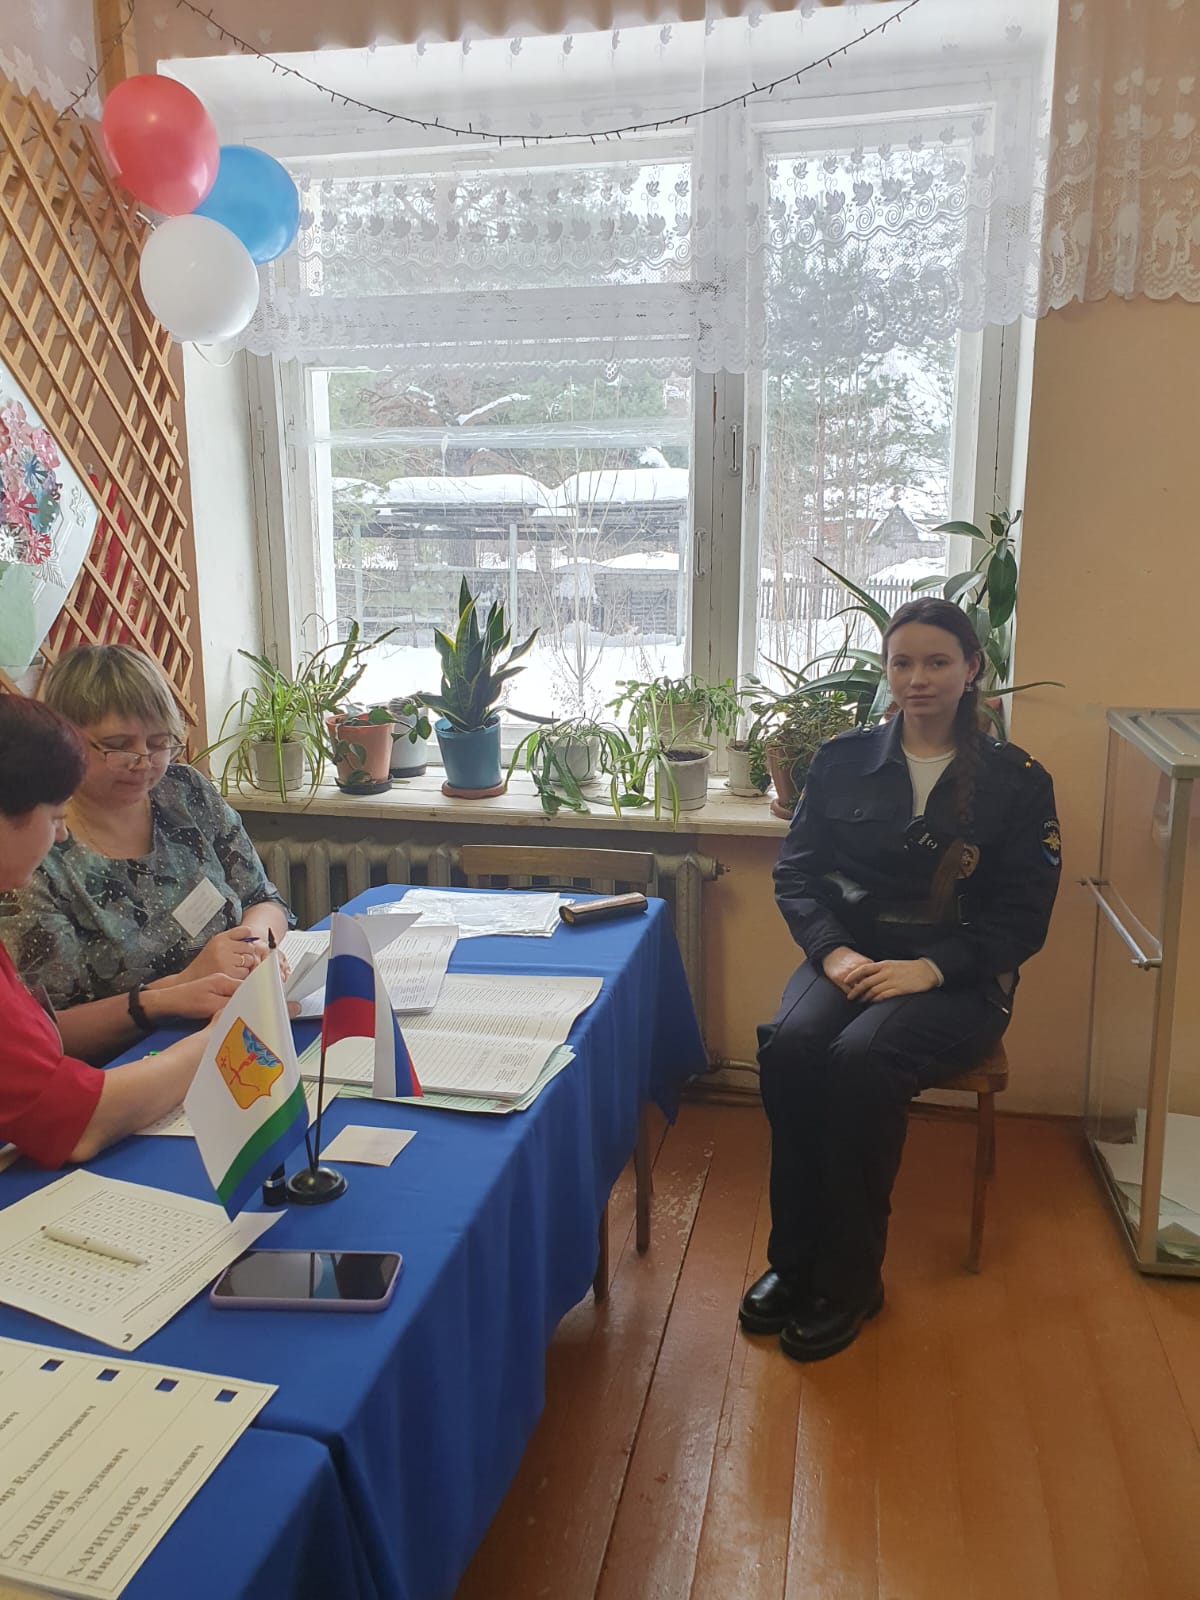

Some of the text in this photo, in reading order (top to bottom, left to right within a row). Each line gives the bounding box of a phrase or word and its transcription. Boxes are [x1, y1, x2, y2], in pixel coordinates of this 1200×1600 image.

[13, 1405, 97, 1485] Владимирович
[0, 1489, 70, 1560] СЛУЦКИЙ
[20, 1448, 129, 1566] Леонид Эдуардович
[66, 1485, 150, 1578] ХАРИТОНОВ
[86, 1445, 205, 1582] Николай Михайлович
